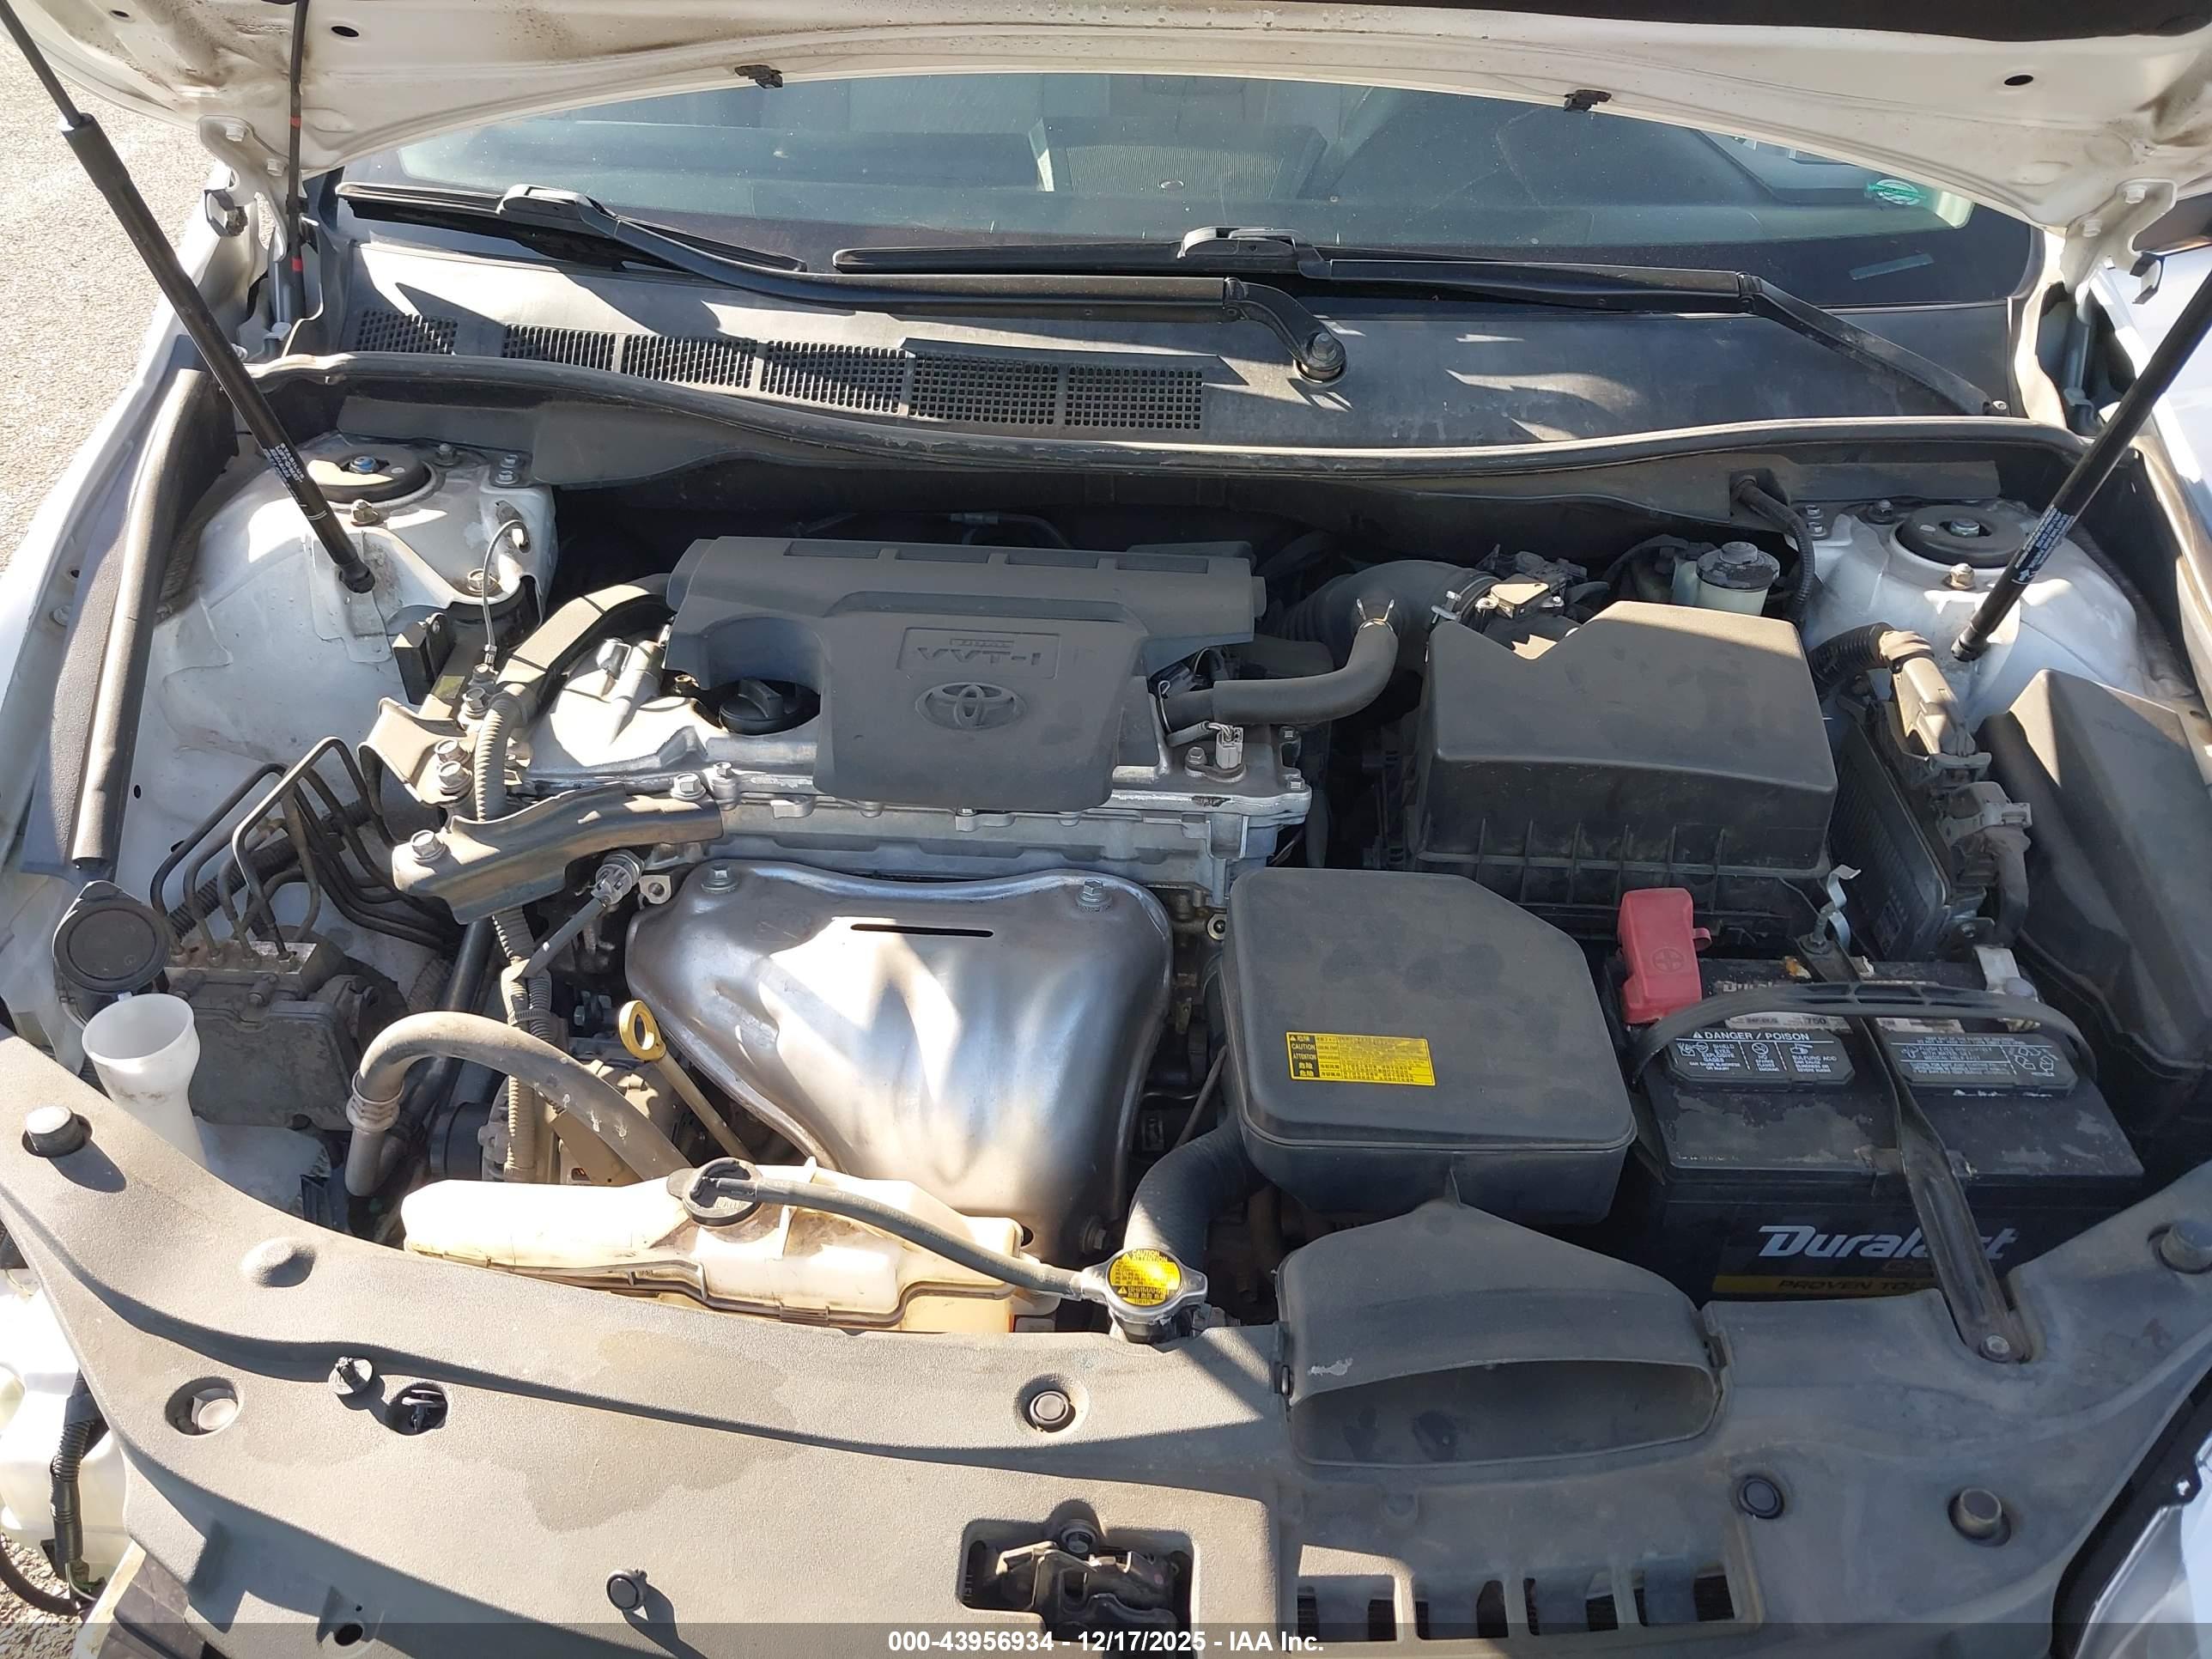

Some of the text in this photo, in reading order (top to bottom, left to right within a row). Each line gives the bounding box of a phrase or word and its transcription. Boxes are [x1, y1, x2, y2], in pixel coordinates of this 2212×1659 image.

[1704, 1031, 1753, 1040] DANGER
[1765, 1032, 1810, 1041] POISON
[1759, 1224, 2019, 1260] Duralt
[1778, 1279, 1872, 1291] PROVEN
